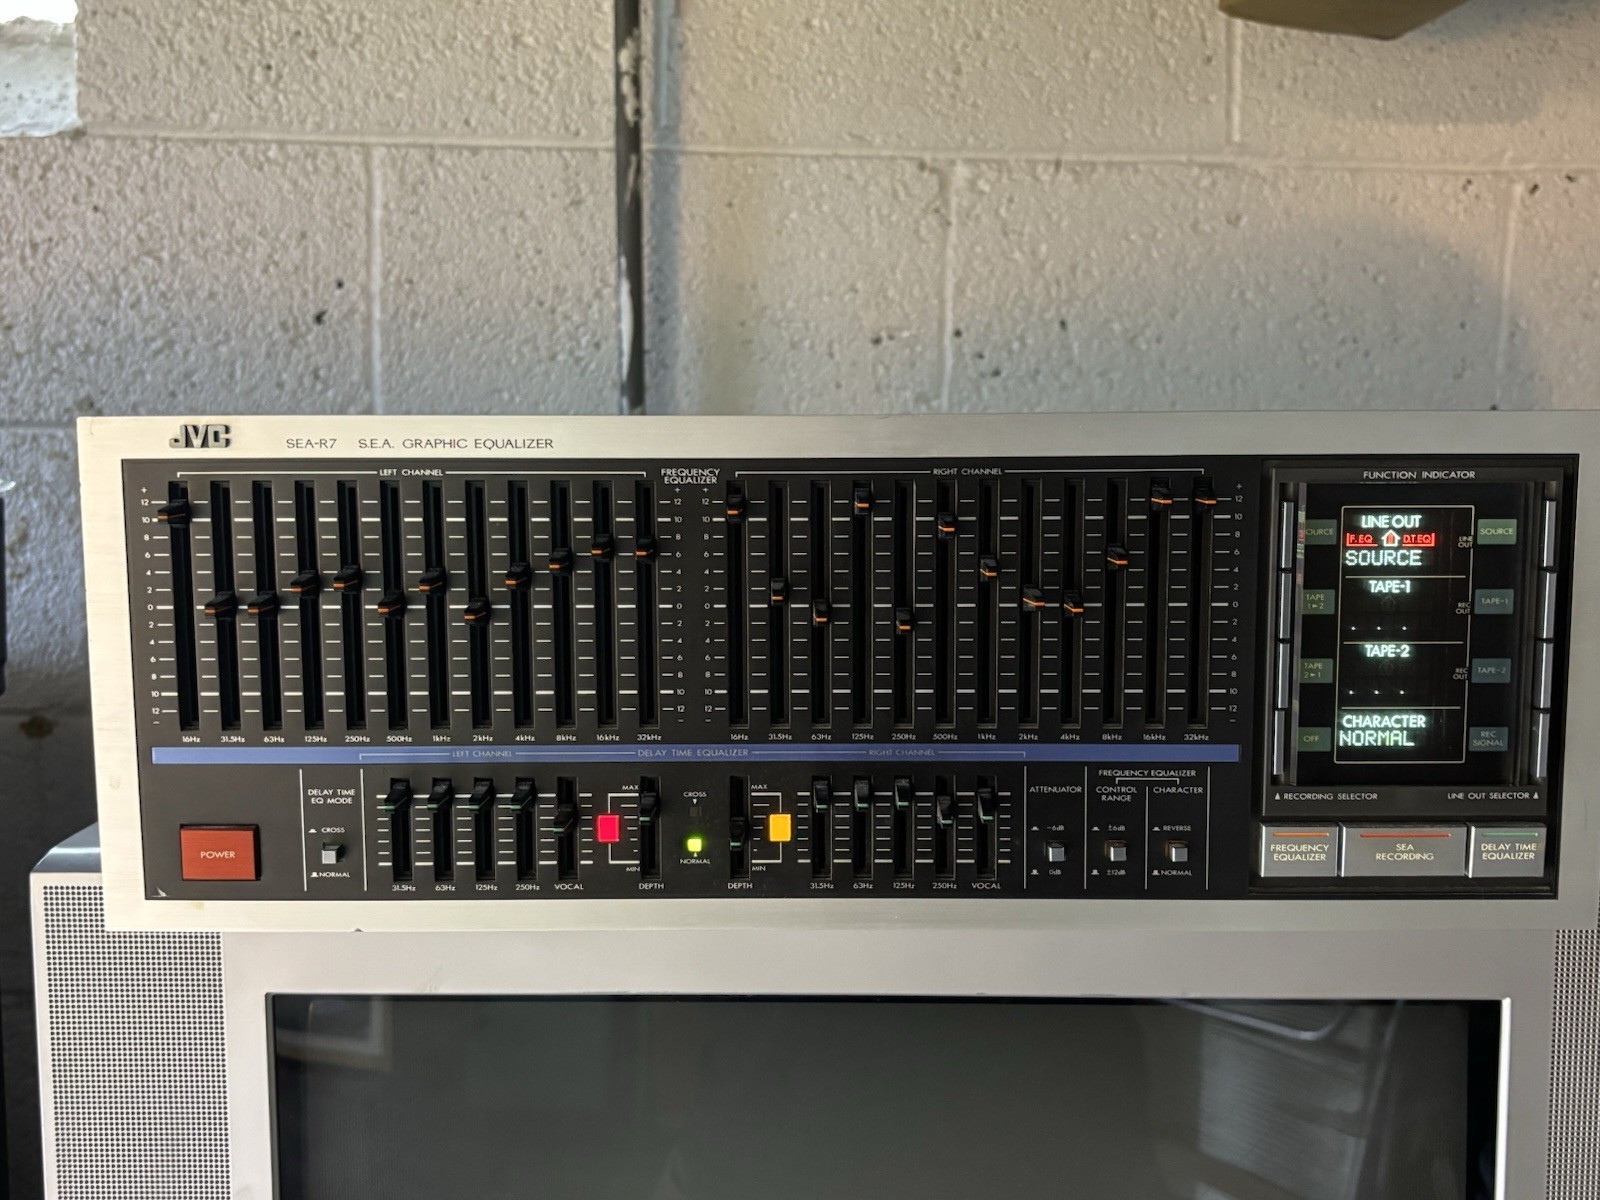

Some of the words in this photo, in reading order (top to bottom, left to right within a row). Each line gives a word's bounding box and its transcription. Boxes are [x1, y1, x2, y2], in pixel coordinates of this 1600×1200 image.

[169, 424, 232, 449] JVC
[286, 438, 337, 450] SEA-R7
[358, 438, 395, 450] S.E.A.
[402, 438, 468, 450] GRAPHIC
[474, 438, 554, 450] EQUALIZER
[402, 468, 444, 476] CHANNEL
[1363, 470, 1417, 479] FUNCTION
[1422, 470, 1476, 479] INDICATOR
[664, 476, 718, 484] EQUALIZER
[1362, 515, 1390, 528] LINE
[1392, 515, 1422, 528] OUT
[1345, 550, 1422, 566] SOURCE
[1369, 580, 1410, 593] TAPE-1
[1364, 644, 1410, 657] TAPE-2
[1342, 715, 1426, 728] CHARACTER
[1339, 730, 1415, 746] NORMAL
[1270, 844, 1329, 852] FREQUENCY
[1273, 853, 1326, 861] EQUALIZER
[1376, 852, 1434, 861] RECORDING
[1482, 852, 1535, 860] EQUALIZER
